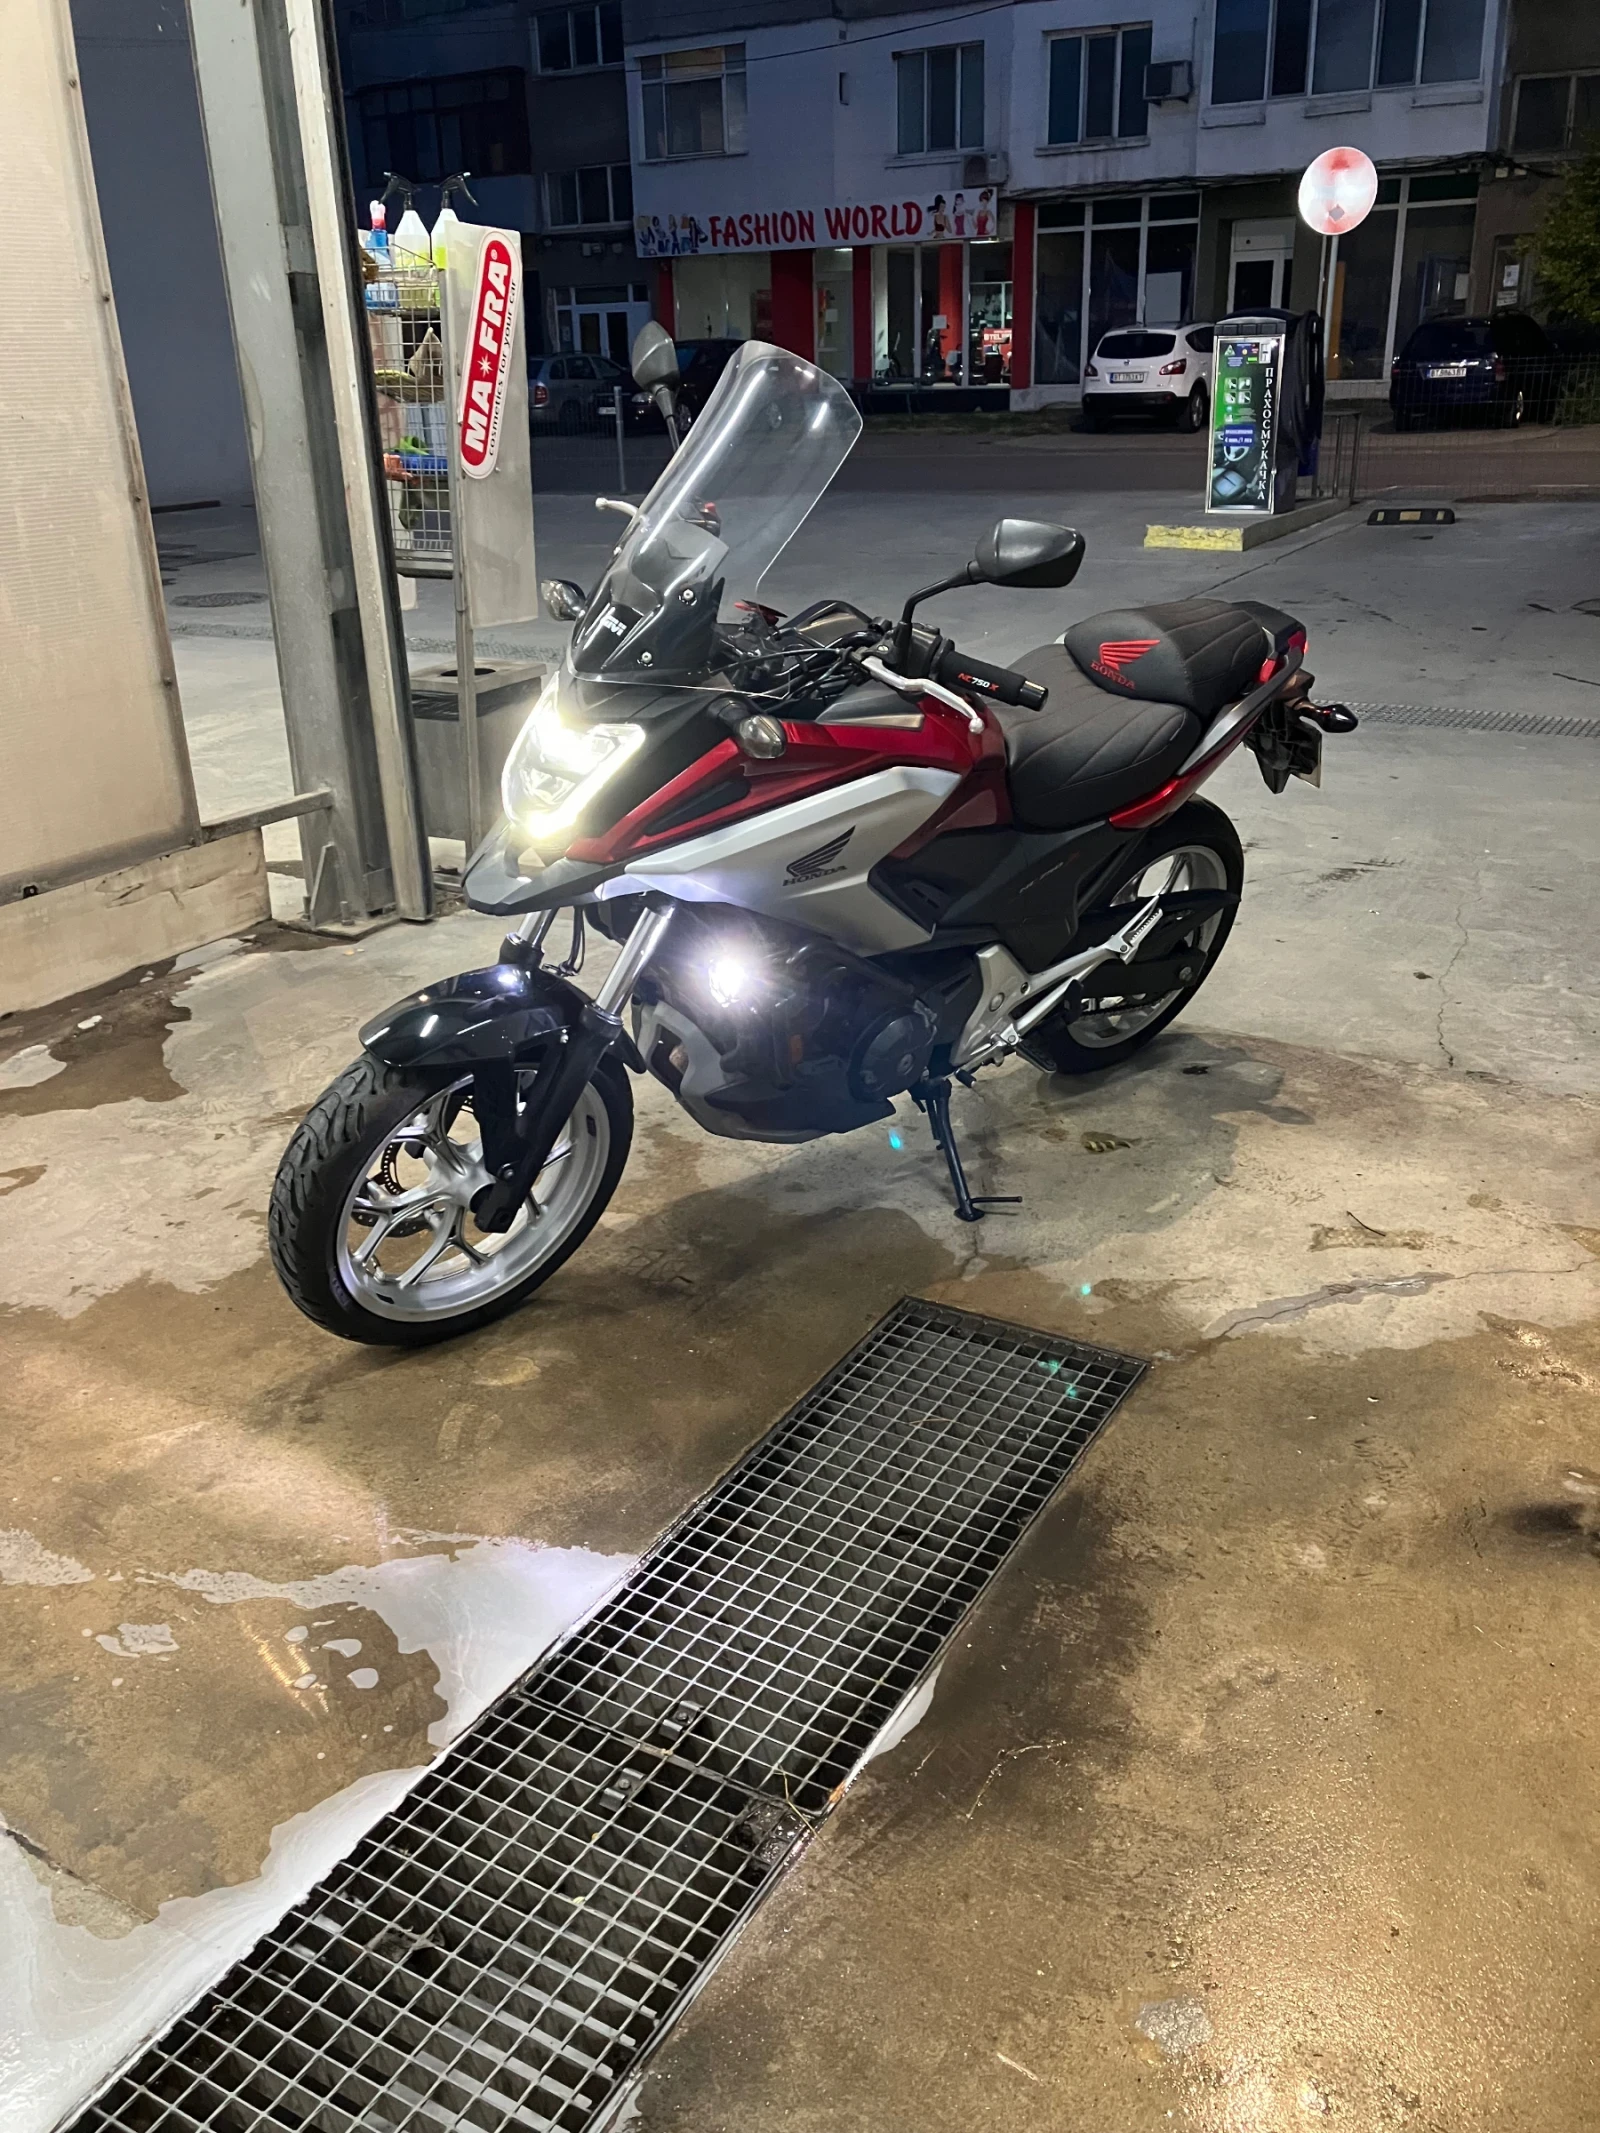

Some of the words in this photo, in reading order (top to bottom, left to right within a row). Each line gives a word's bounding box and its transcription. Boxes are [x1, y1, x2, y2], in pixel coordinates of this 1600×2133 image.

[709, 209, 816, 247] FASHION
[824, 201, 923, 241] WORLD
[489, 381, 503, 456] cosmetics
[499, 353, 507, 374] for
[504, 312, 513, 349] your
[509, 280, 517, 304] car
[1257, 367, 1274, 500] ПРАХОСМУКАЧКА
[1090, 659, 1136, 690] HONDA
[782, 865, 848, 887] HONDA
